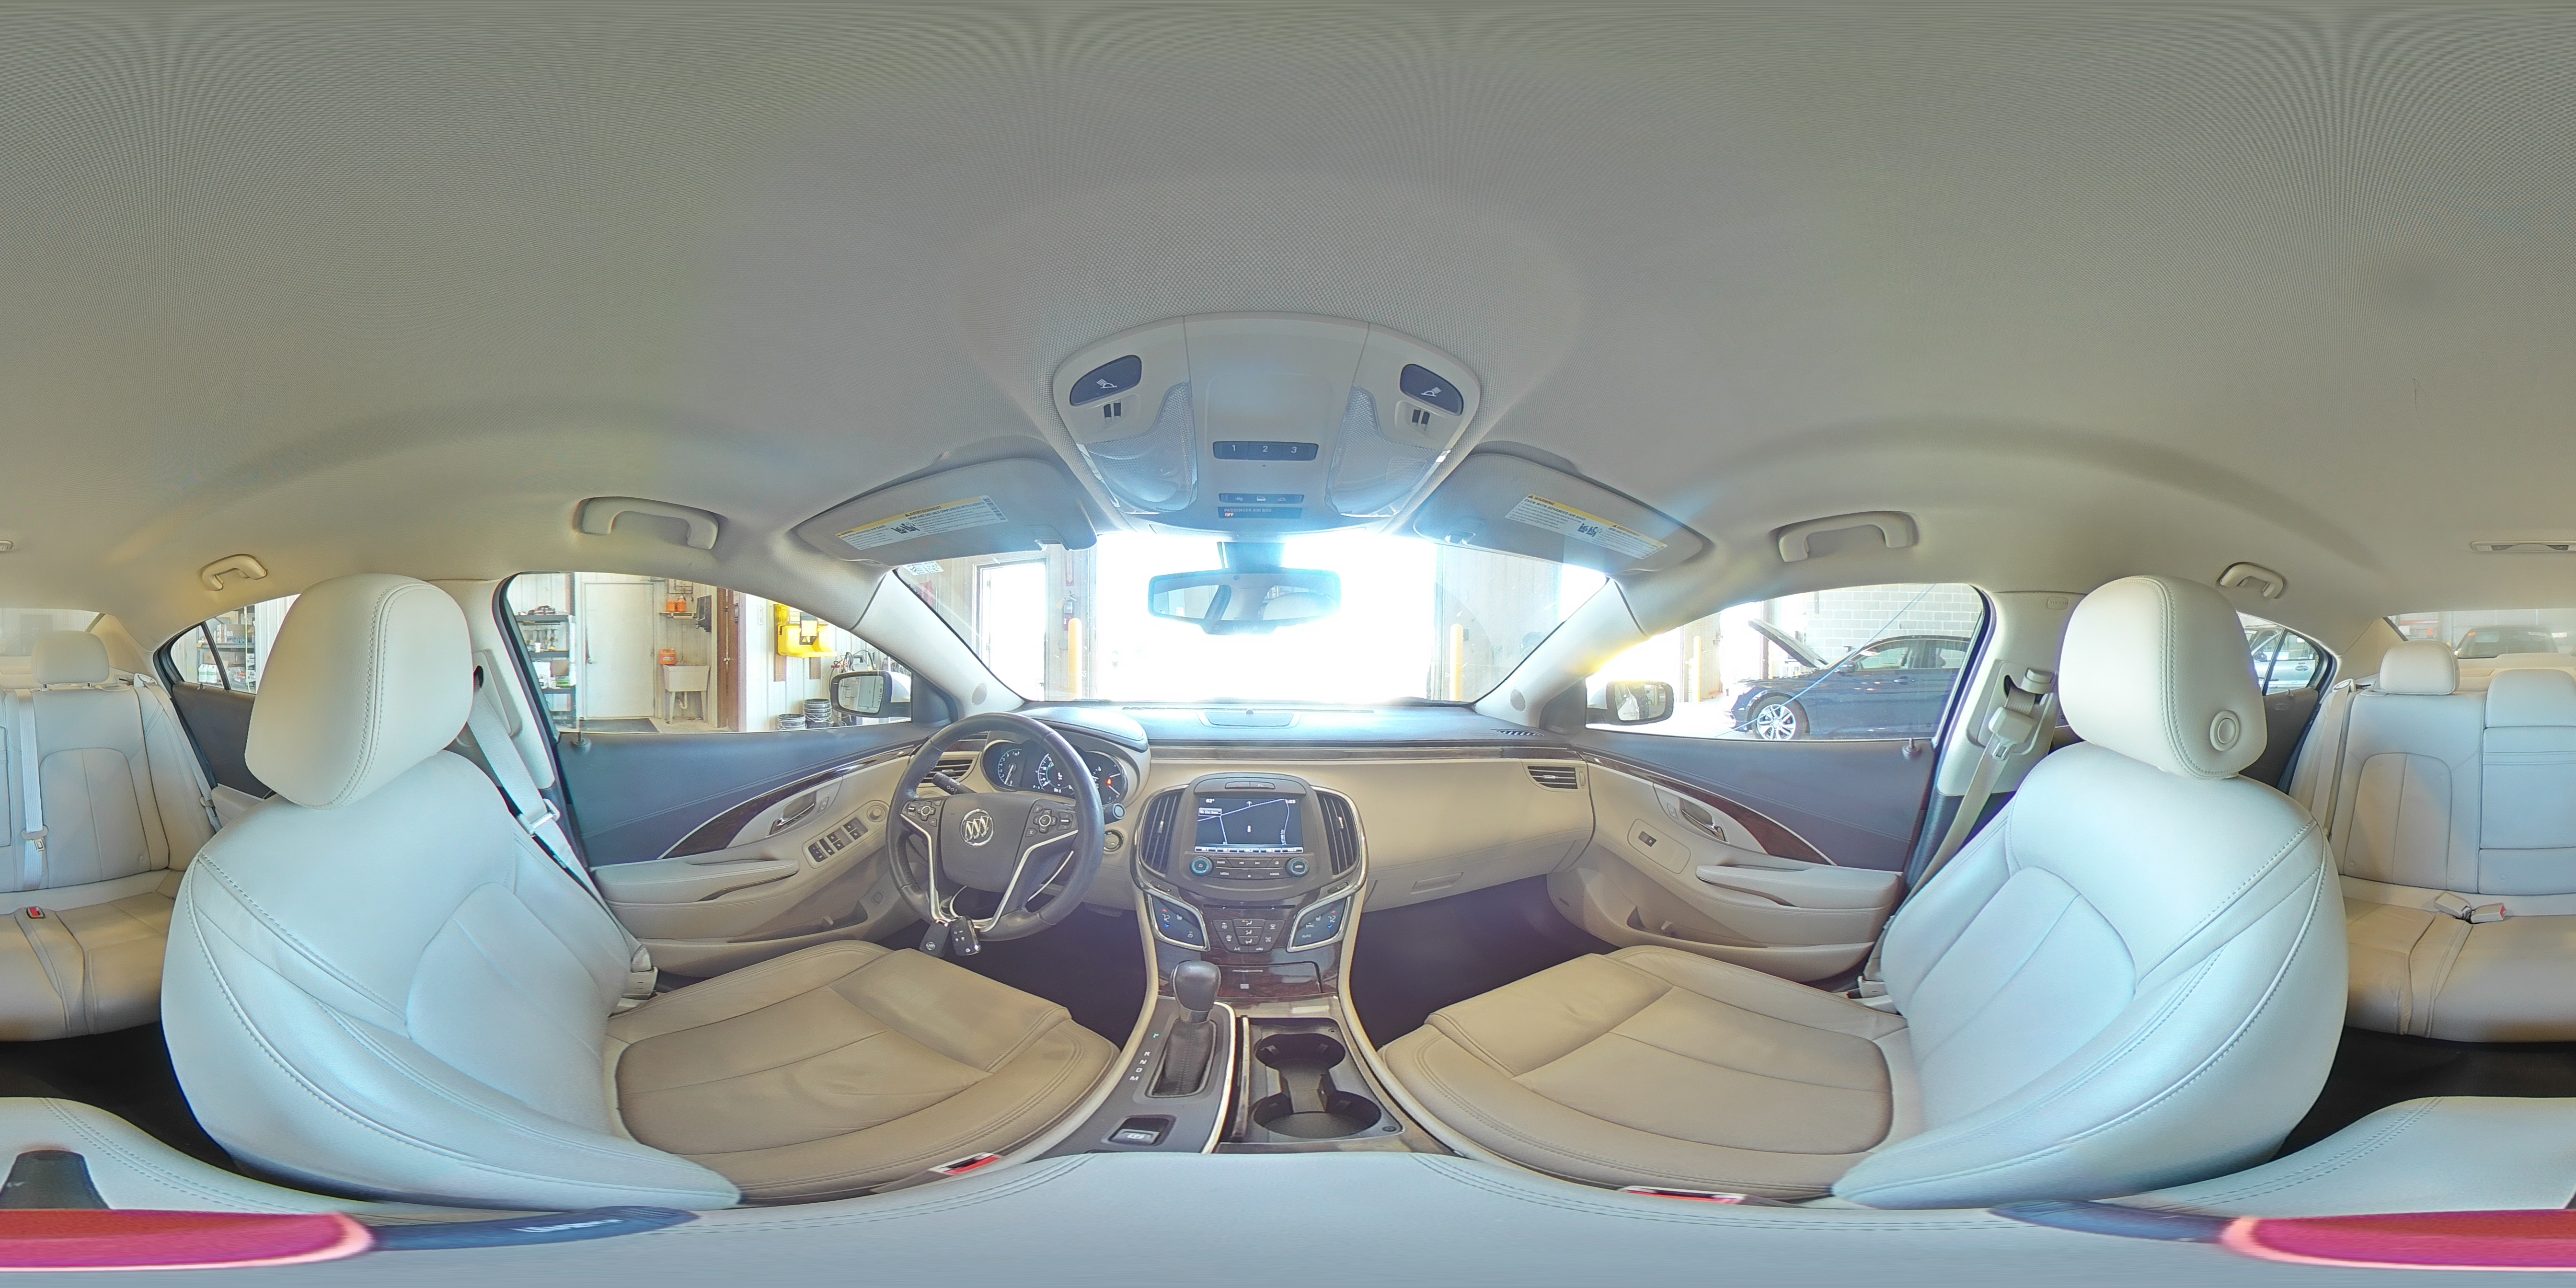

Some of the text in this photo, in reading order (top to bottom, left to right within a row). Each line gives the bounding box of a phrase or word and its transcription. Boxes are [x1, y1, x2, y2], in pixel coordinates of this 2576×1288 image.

[1534, 496, 1555, 506] WARNING
[909, 506, 942, 516] AVERTISSEMENT
[1547, 505, 1569, 515] ADVANCED
[1162, 913, 1170, 922] 72
